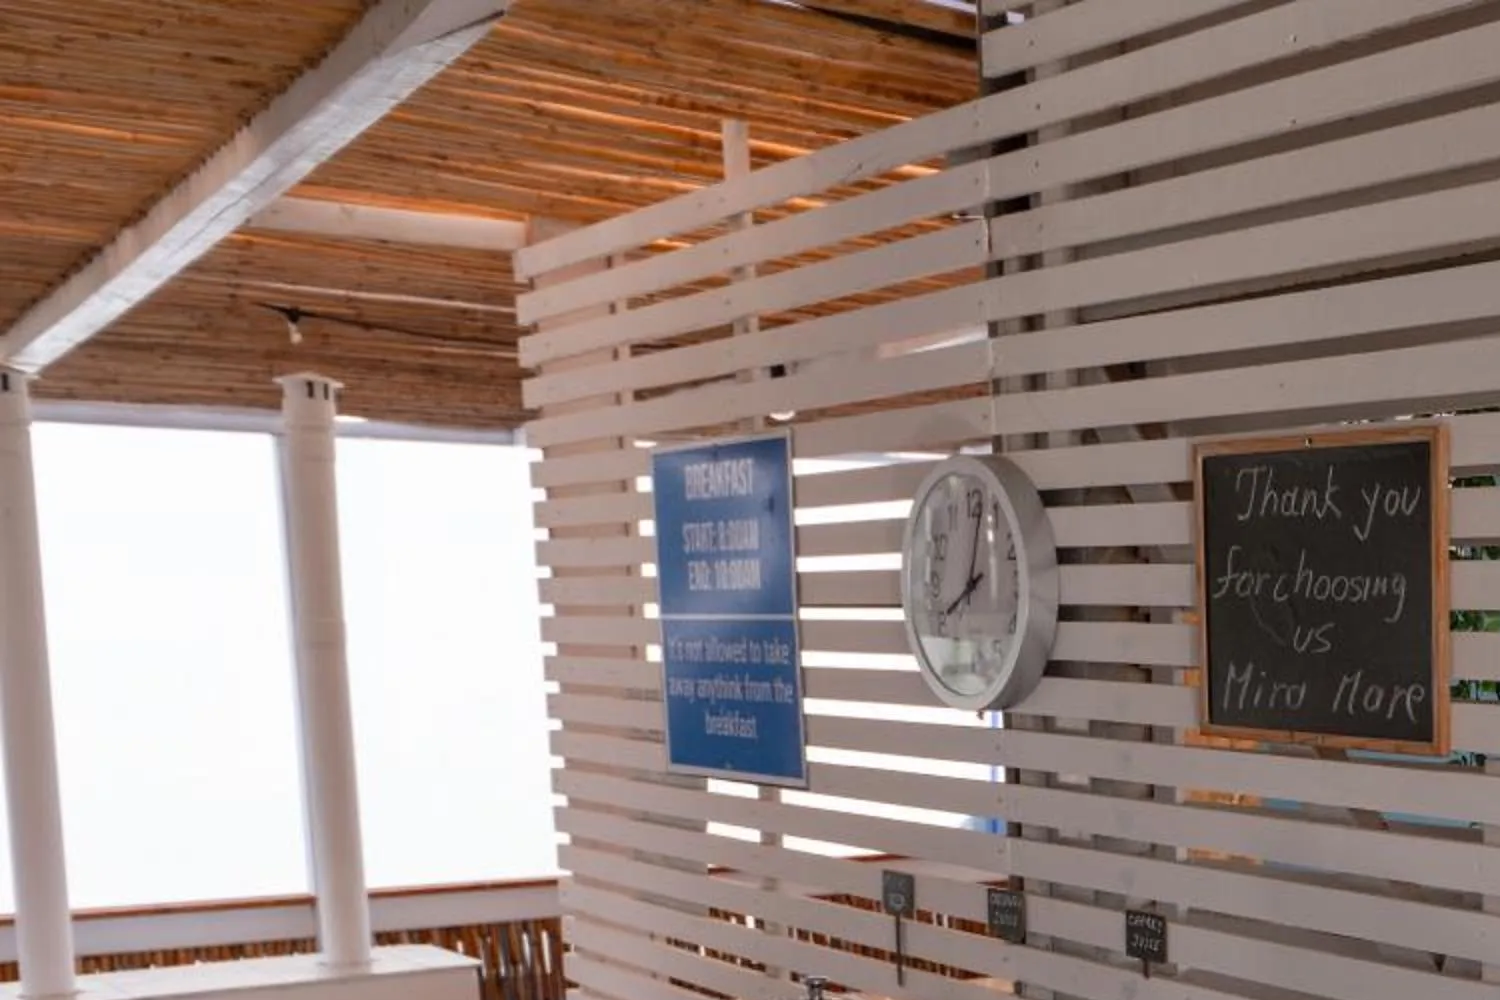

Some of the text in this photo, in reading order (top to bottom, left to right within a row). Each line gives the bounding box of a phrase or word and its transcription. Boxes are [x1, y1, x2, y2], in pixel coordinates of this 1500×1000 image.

[684, 457, 754, 501] BREAKFAST
[967, 488, 983, 519] 12
[1235, 465, 1421, 541] Thank you
[682, 520, 716, 554] START:
[688, 559, 712, 592] END:
[1213, 545, 1406, 623] for choosing
[685, 639, 703, 663] not
[704, 635, 747, 664] allowed
[749, 639, 762, 664] to
[763, 637, 790, 665] take
[1293, 622, 1336, 654] us
[668, 677, 695, 704] away
[744, 671, 772, 703] from
[773, 676, 793, 704] the
